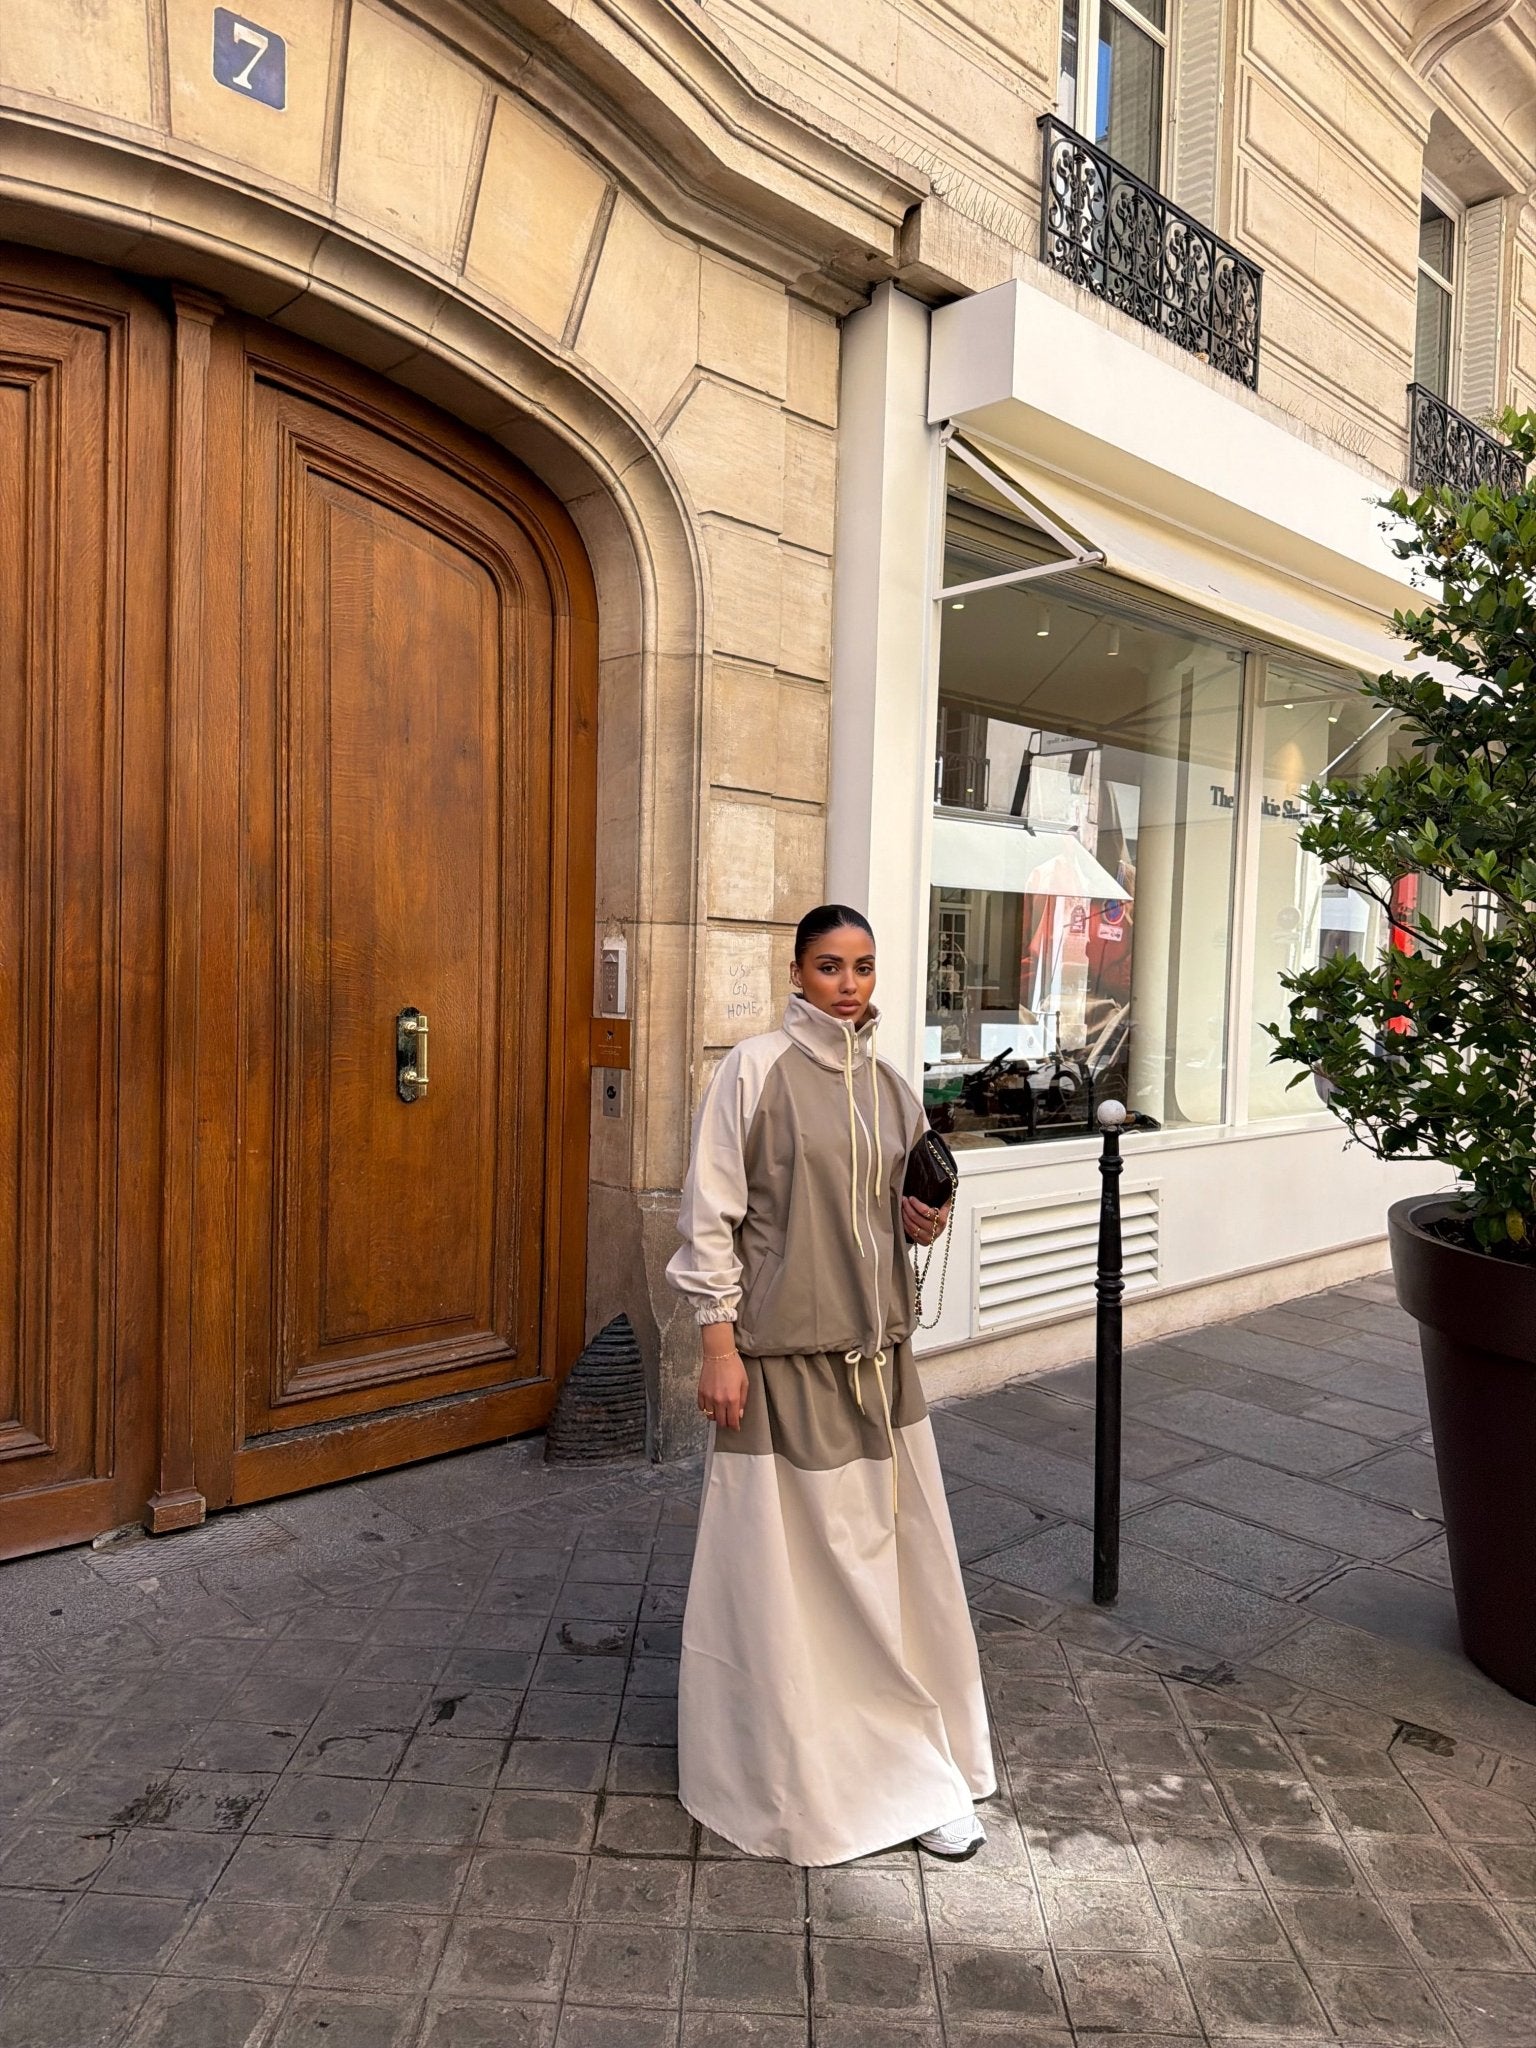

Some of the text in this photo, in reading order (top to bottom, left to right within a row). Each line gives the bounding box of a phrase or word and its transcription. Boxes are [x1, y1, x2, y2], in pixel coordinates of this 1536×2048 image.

[232, 21, 269, 90] 7
[1210, 785, 1234, 808] The
[729, 964, 746, 979] US
[732, 981, 748, 996] GO
[727, 1001, 758, 1019] HOME
